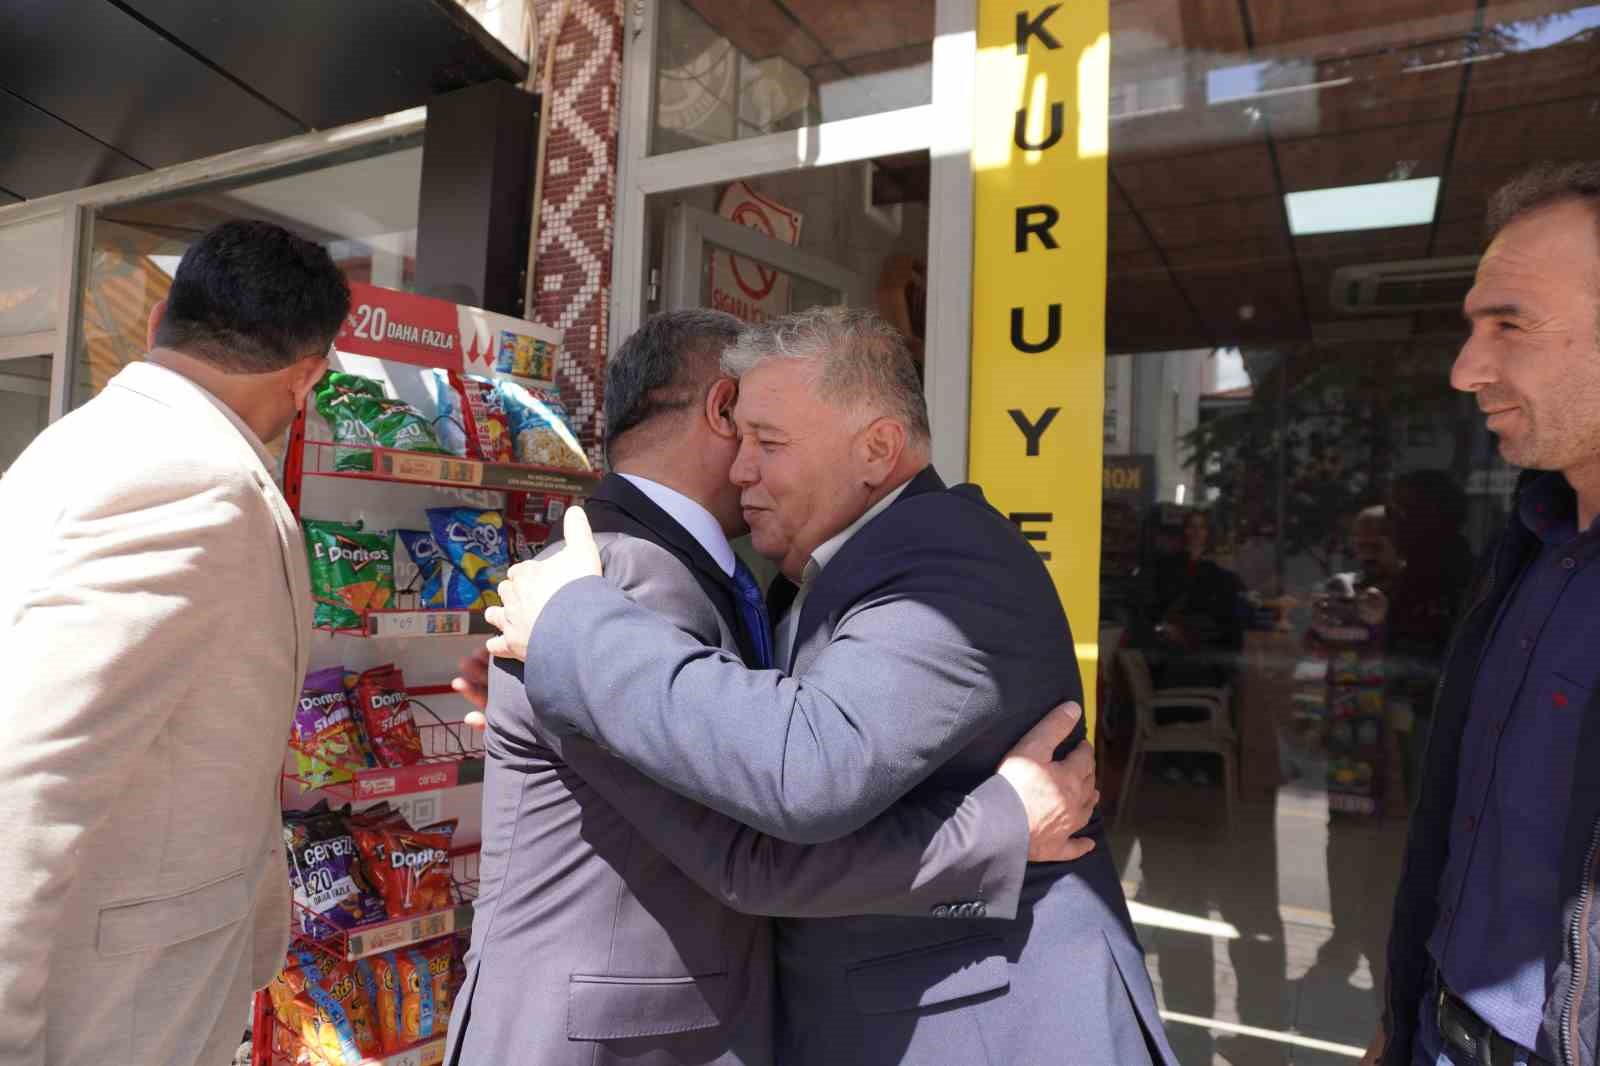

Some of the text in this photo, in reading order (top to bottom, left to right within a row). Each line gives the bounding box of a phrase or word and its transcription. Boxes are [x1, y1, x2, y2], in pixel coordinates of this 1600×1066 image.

[387, 322, 418, 342] DAHA
[421, 328, 453, 349] FAZLA
[328, 546, 389, 562] Doritos
